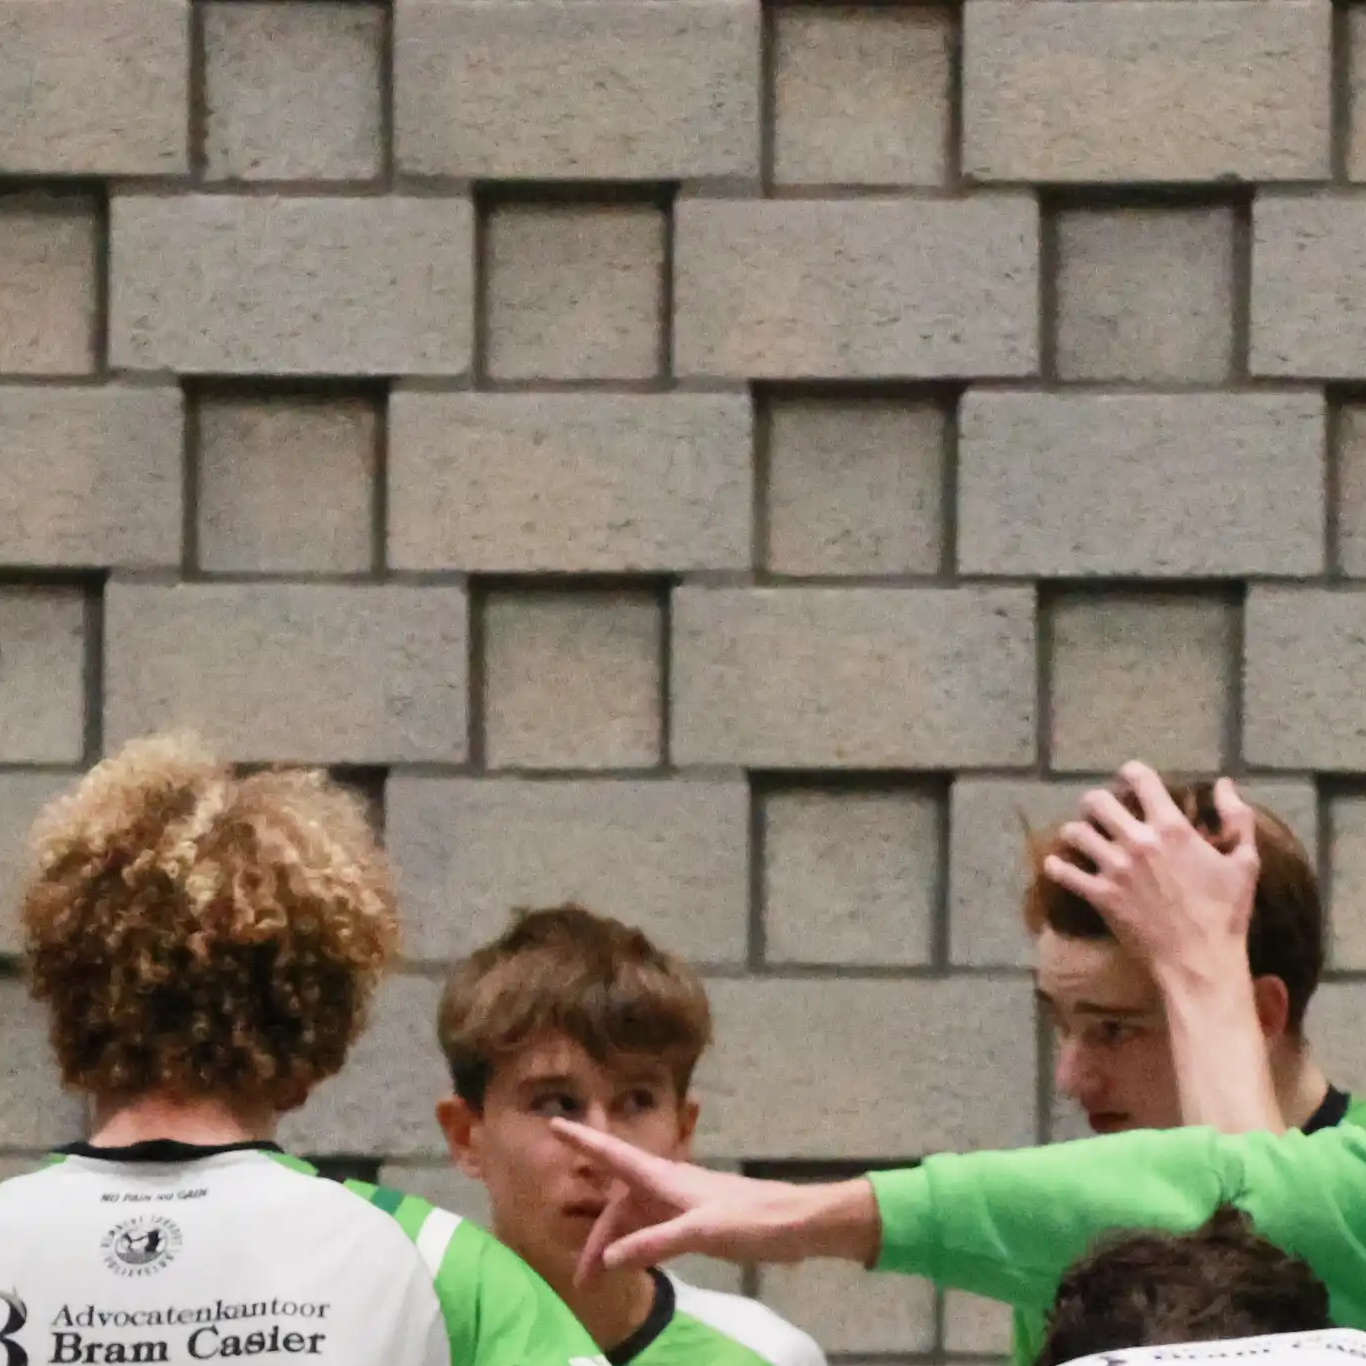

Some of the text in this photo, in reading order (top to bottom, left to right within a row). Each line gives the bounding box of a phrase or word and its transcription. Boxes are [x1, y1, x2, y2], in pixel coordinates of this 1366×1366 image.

[50, 1298, 331, 1328] Advocatenkantoor
[47, 1325, 327, 1366] Bram Casier
